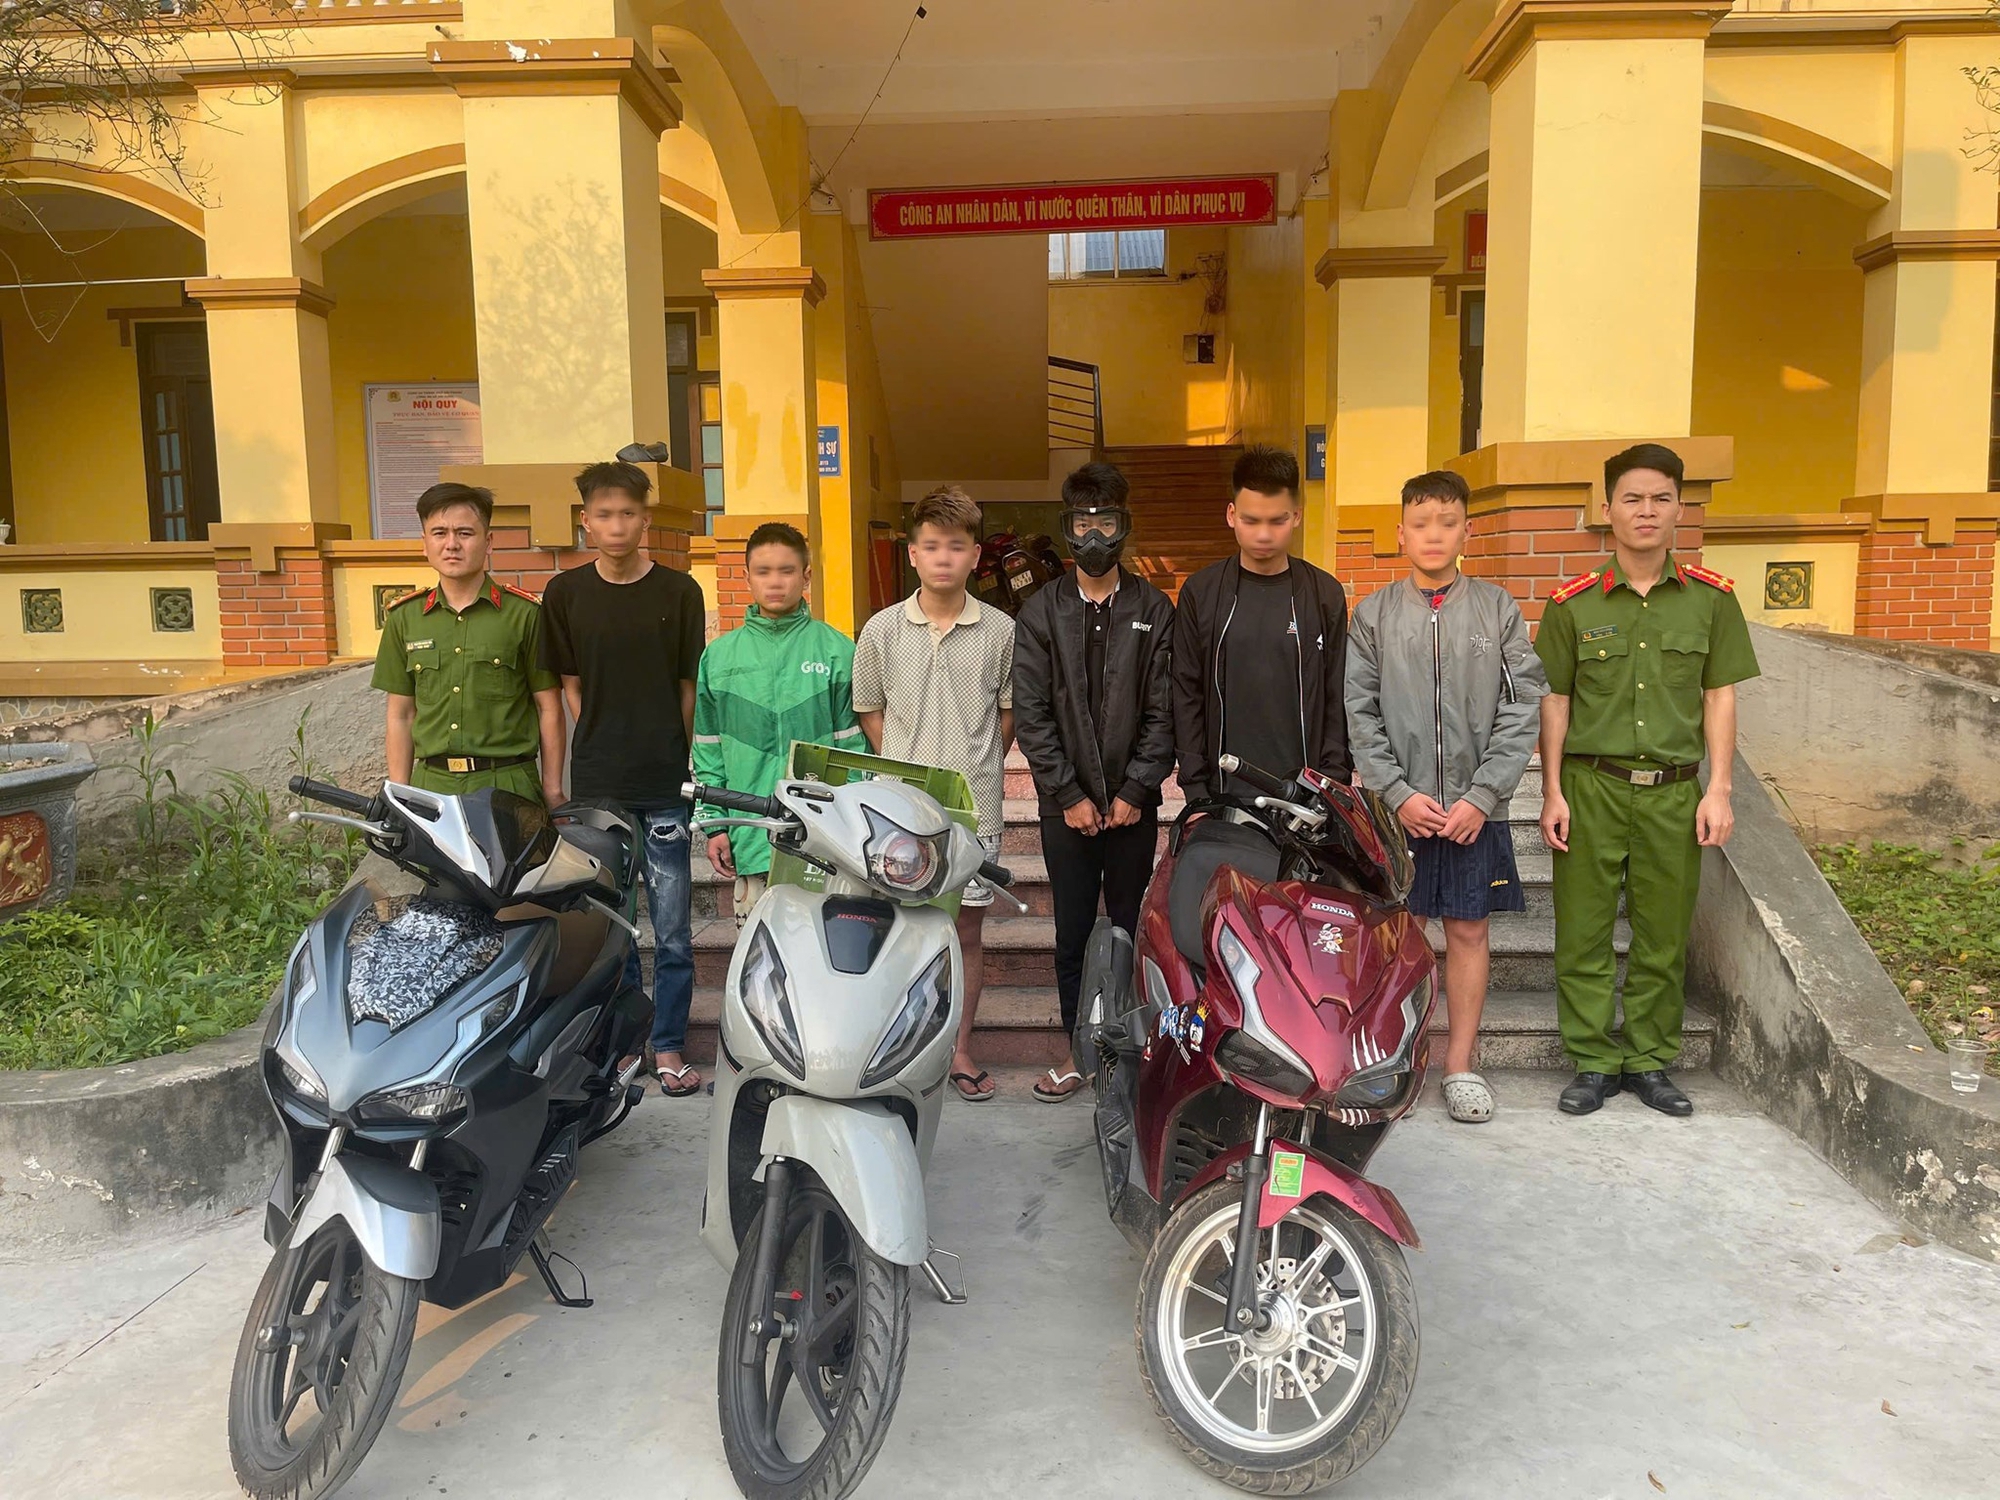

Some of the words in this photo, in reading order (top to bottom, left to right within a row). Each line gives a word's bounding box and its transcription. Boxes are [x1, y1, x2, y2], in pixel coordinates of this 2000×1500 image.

[900, 201, 932, 226] CÔNG
[936, 204, 953, 225] AN
[956, 199, 990, 224] NHÂN
[993, 197, 1022, 224] DÂN,
[1024, 196, 1036, 221] VÌ
[1039, 194, 1072, 220] NƯỚC
[1075, 193, 1108, 221] QUÊN
[1111, 192, 1147, 219] THÂN,
[1150, 190, 1162, 216] VÌ
[1165, 190, 1190, 216] DÂN
[1193, 192, 1226, 218] PHỤC
[1229, 191, 1246, 217] VỤ
[413, 399, 432, 410] NỘI
[436, 400, 458, 409] QUY
[826, 441, 837, 457] SỰ
[836, 913, 878, 923] HONDA
[1310, 902, 1356, 919] HONDA
